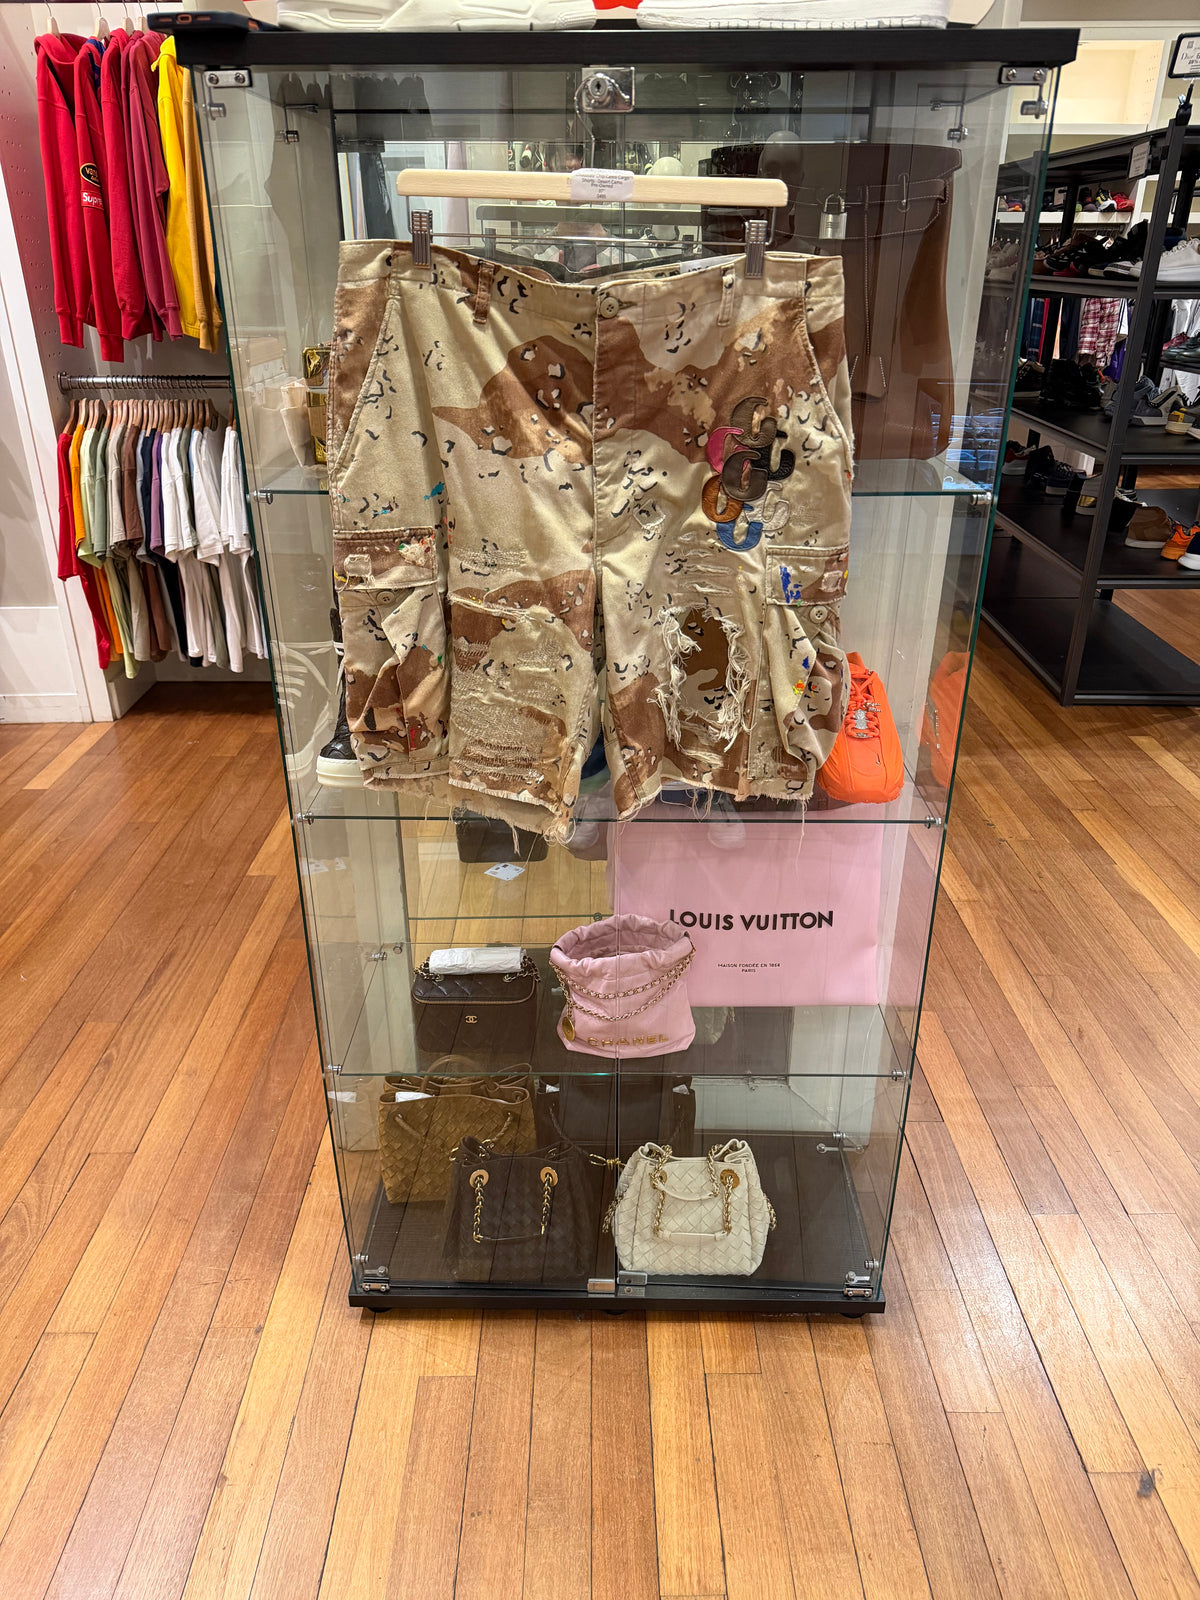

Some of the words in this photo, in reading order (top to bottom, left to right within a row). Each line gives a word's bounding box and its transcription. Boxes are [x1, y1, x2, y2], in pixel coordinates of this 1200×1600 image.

[670, 908, 734, 931] LOUIS
[740, 910, 834, 931] VUITTON
[587, 1033, 669, 1047] CHANEL
